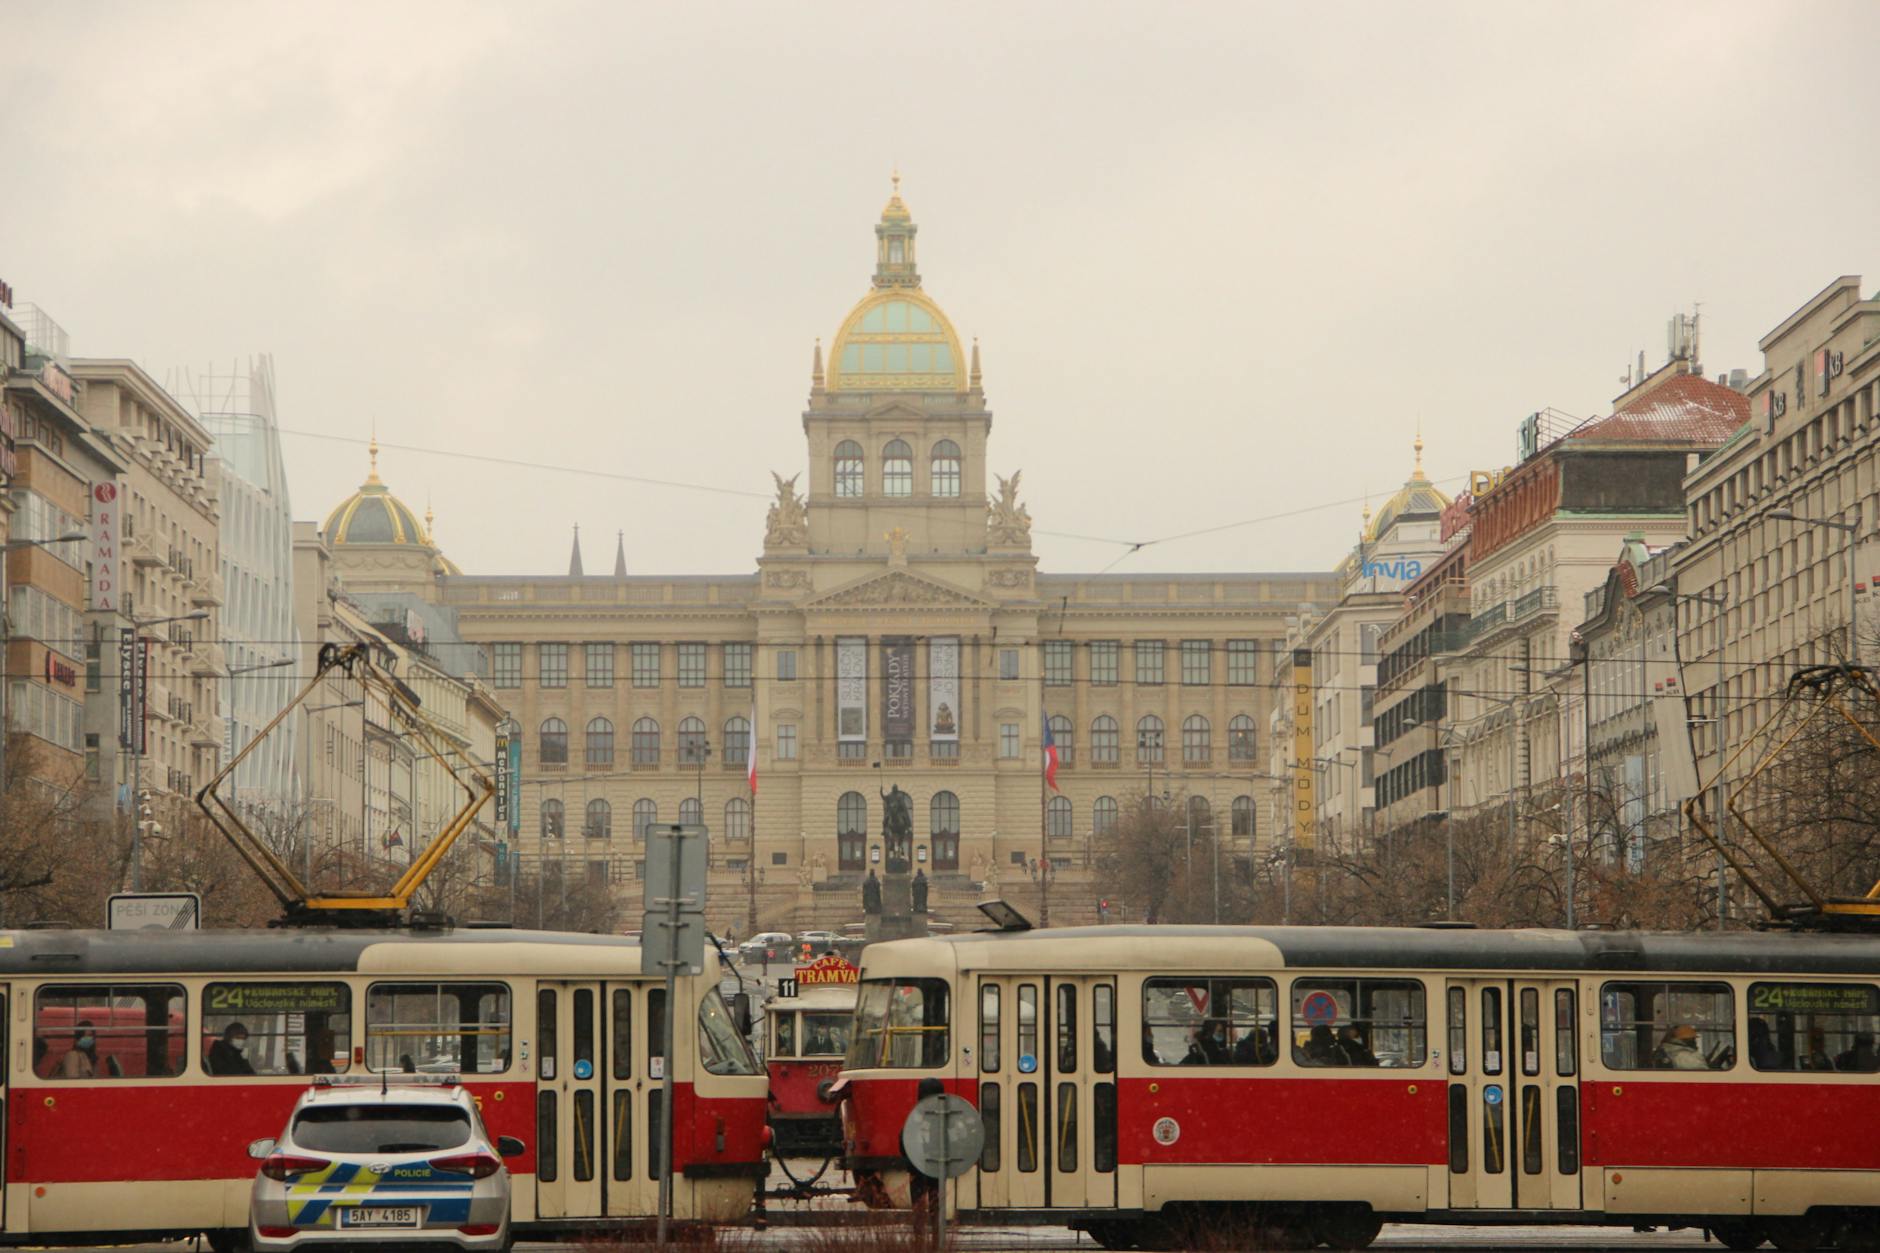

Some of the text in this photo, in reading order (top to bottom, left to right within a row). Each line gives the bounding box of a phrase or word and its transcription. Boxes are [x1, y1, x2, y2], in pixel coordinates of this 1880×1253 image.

[98, 513, 113, 609] RAMADA
[211, 987, 244, 1009] 24
[782, 980, 796, 997] 11
[1754, 986, 1784, 1008] 24
[394, 1168, 431, 1177] POLICIE
[352, 1208, 411, 1222] 5AY 4185
